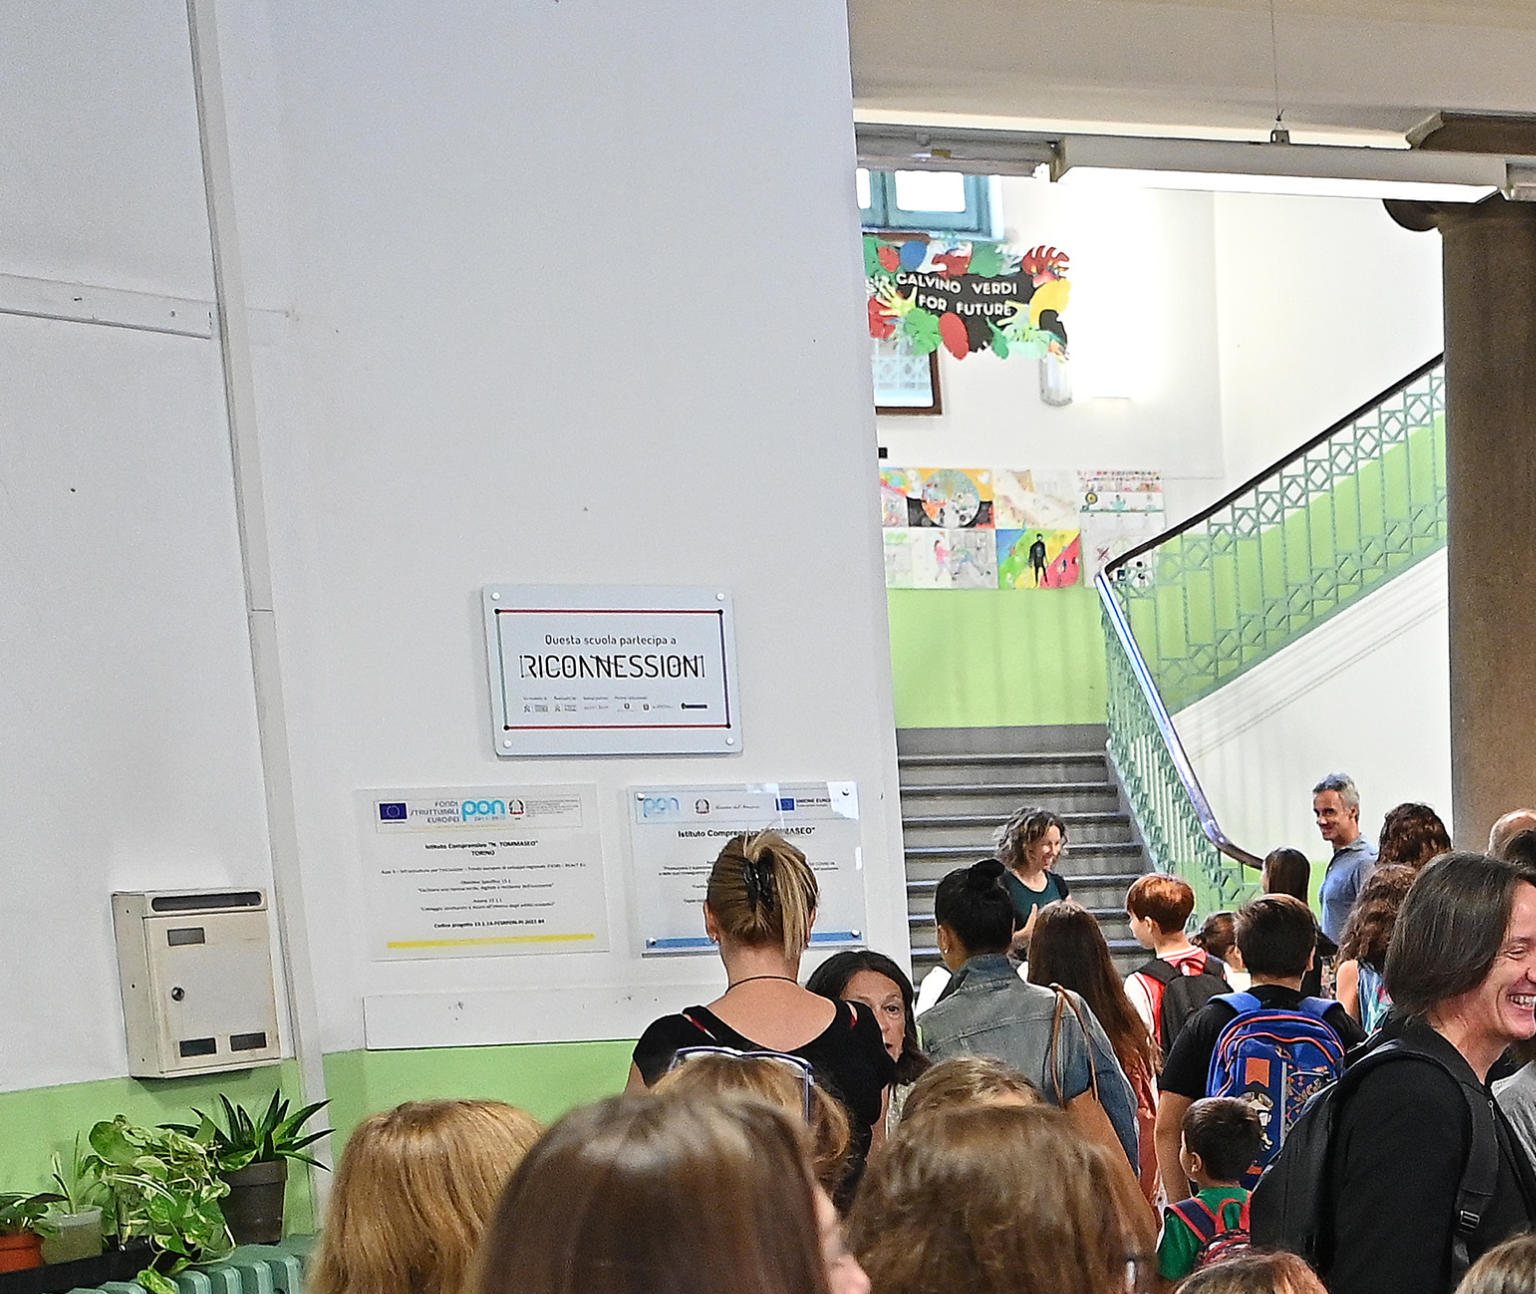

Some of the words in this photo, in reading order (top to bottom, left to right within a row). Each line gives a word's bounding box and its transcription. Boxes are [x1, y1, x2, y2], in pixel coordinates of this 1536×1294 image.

[896, 273, 962, 294] CALVINO
[971, 283, 1017, 295] VERDI
[918, 294, 947, 311] FOR
[956, 302, 1012, 316] FUTURE
[545, 634, 581, 645] Questa
[583, 635, 617, 645] scuola
[619, 636, 668, 648] partecipa
[462, 799, 506, 822] pon
[678, 829, 706, 839] Istituto
